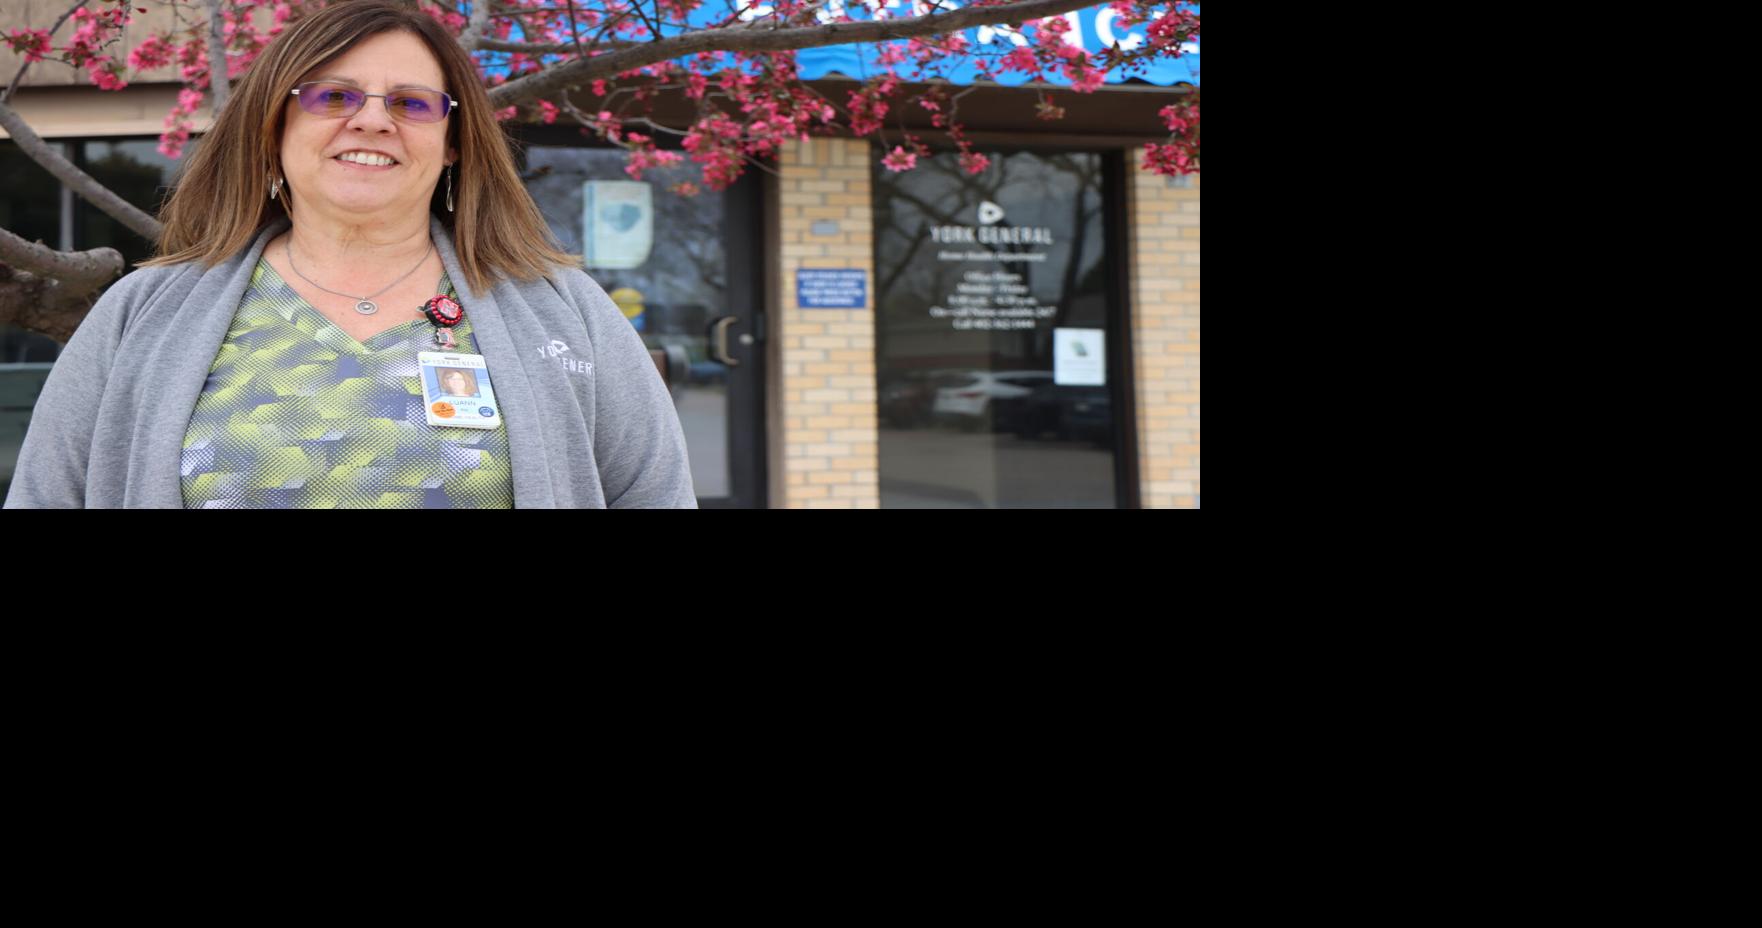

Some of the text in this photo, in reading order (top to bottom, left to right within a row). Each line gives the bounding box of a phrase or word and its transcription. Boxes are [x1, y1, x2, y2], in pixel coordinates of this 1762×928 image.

[930, 226, 1053, 244] YORK GENERAL
[537, 345, 557, 359] YO
[562, 357, 593, 376] ENER
